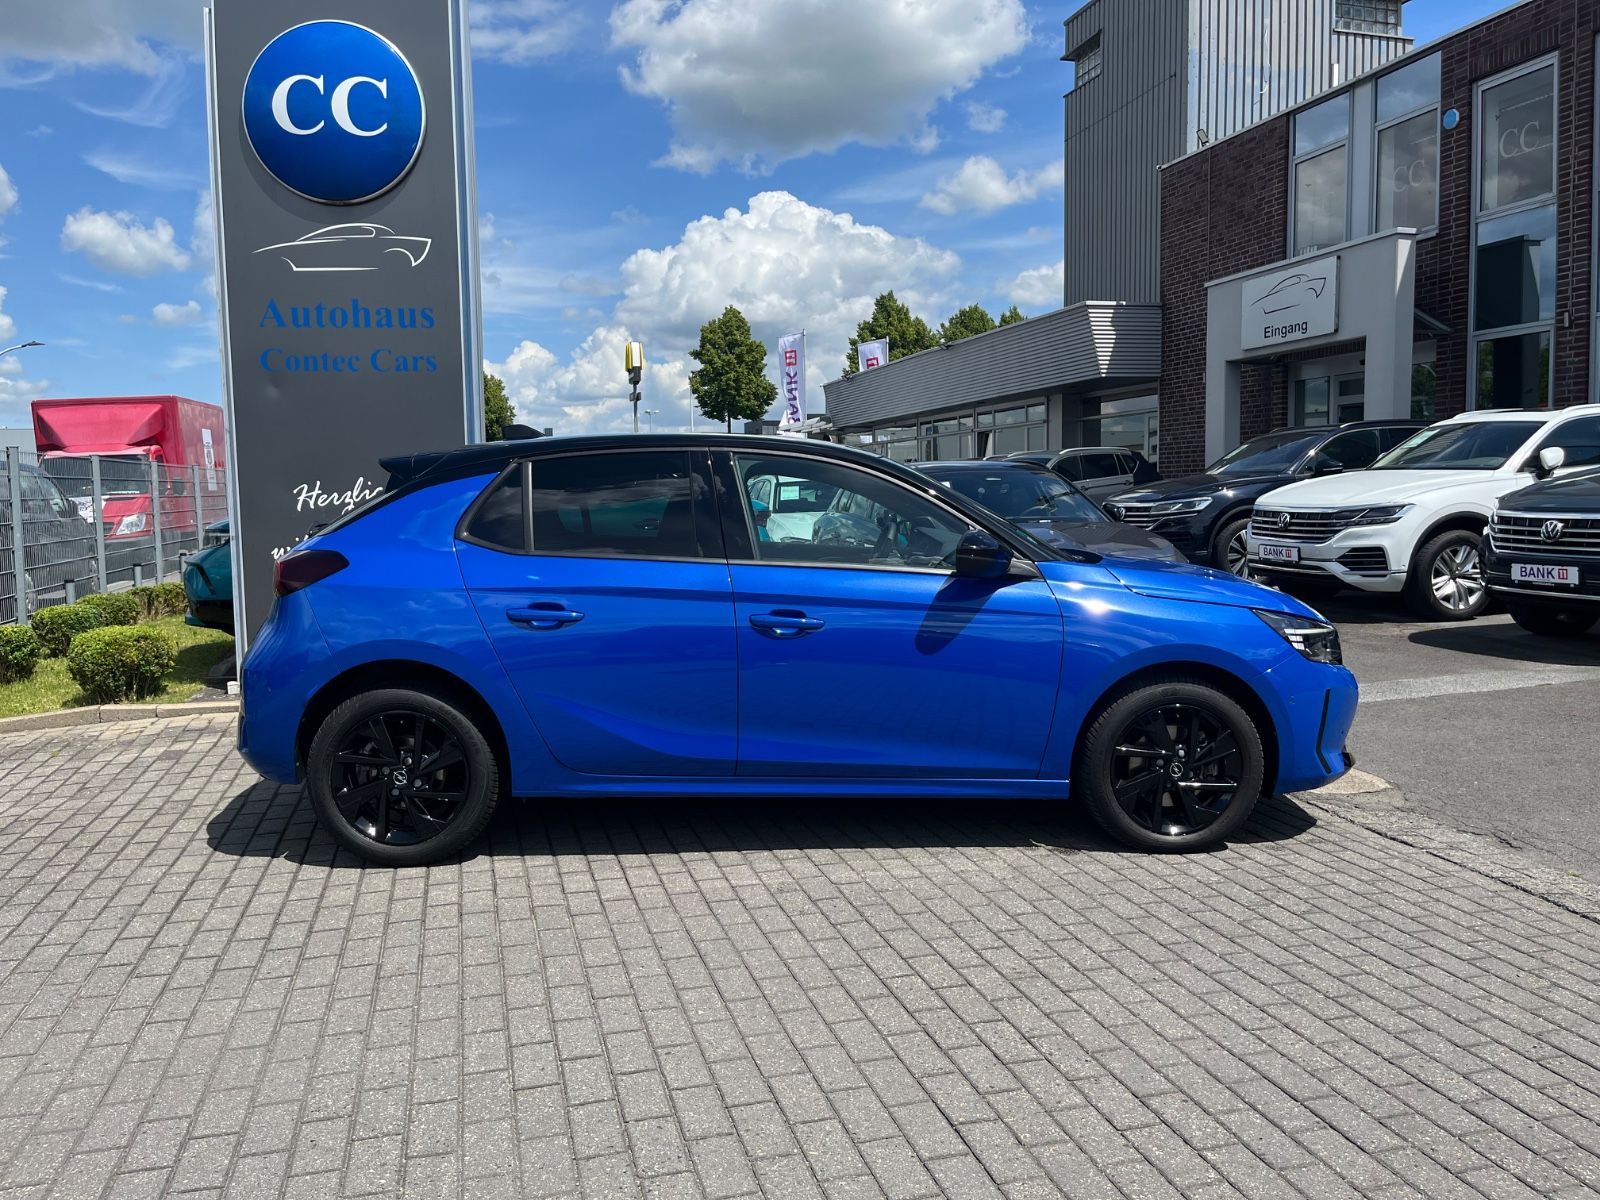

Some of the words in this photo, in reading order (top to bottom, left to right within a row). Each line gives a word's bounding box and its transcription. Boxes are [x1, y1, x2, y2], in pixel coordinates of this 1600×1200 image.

[271, 74, 388, 137] CC
[1500, 121, 1540, 158] CC
[1393, 159, 1425, 193] CC
[258, 298, 436, 329] Autohaus
[1264, 321, 1308, 339] Eingang
[260, 348, 361, 373] Contec
[370, 348, 438, 373] Cars
[1263, 547, 1285, 558] BANK
[1520, 566, 1555, 580] BANK
